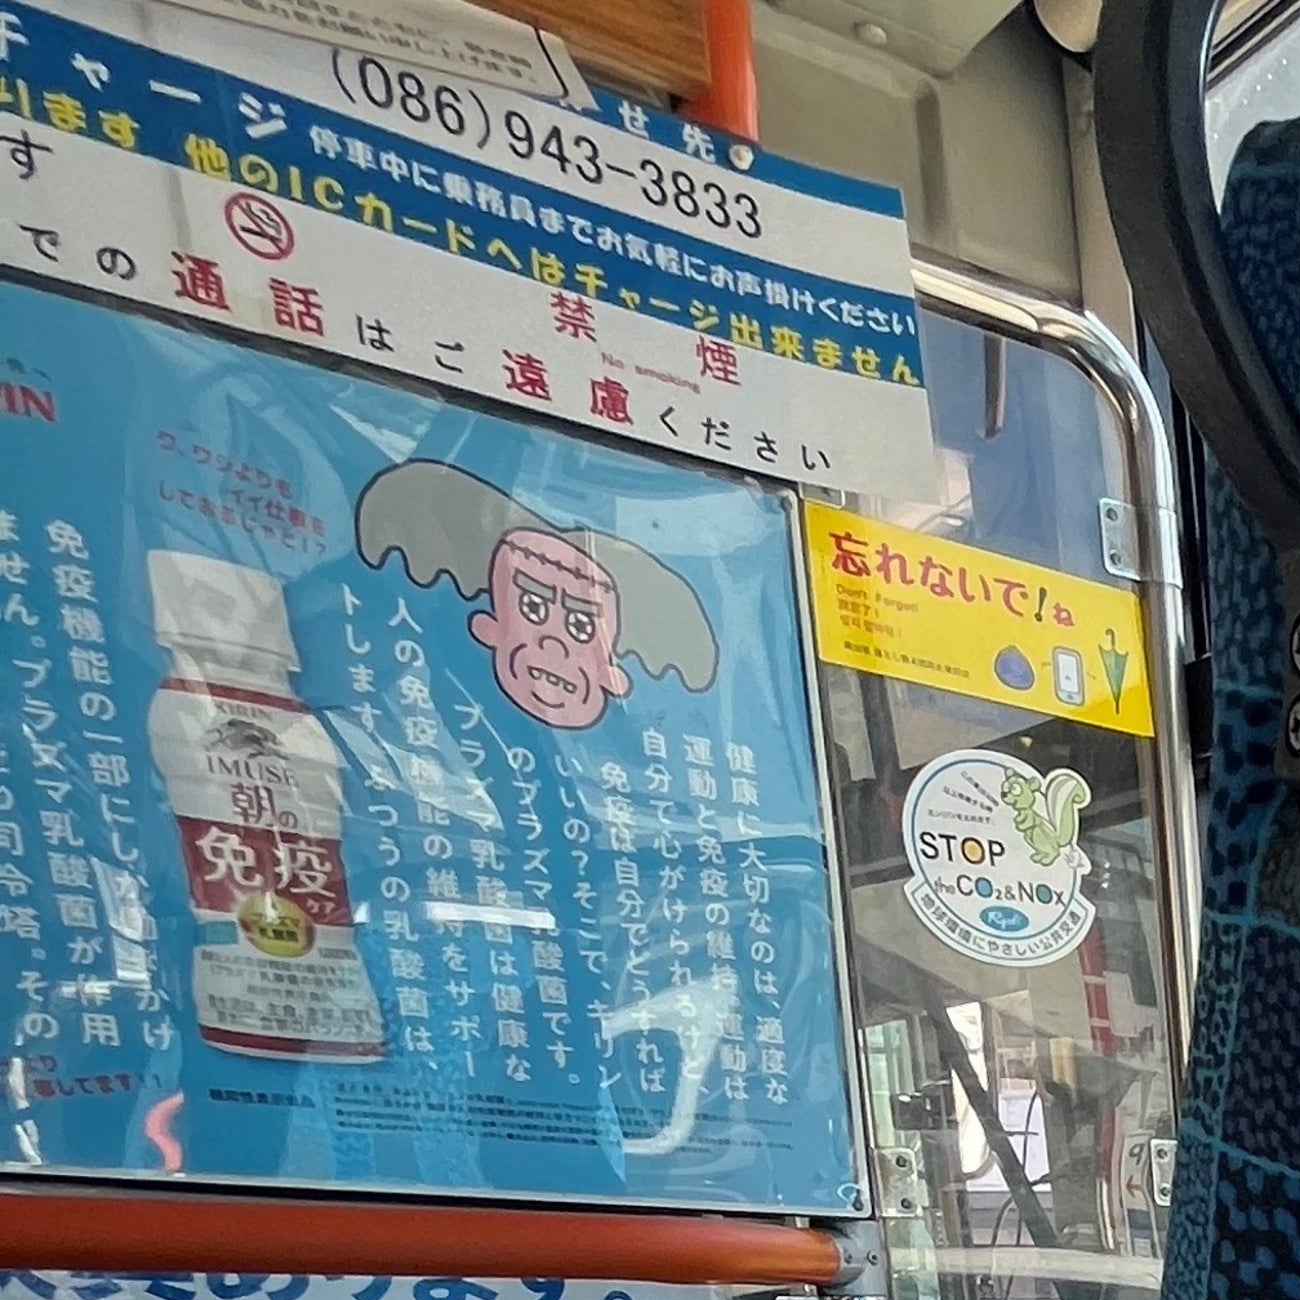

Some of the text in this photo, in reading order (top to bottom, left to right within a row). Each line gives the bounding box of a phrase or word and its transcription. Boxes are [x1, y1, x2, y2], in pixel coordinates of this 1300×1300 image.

[331, 48, 763, 239] (086)943-3833
[194, 826, 336, 899] 免疫
[341, 582, 441, 1073] トしますふつうの乳酸菌は、
[919, 830, 1006, 868] STOP
